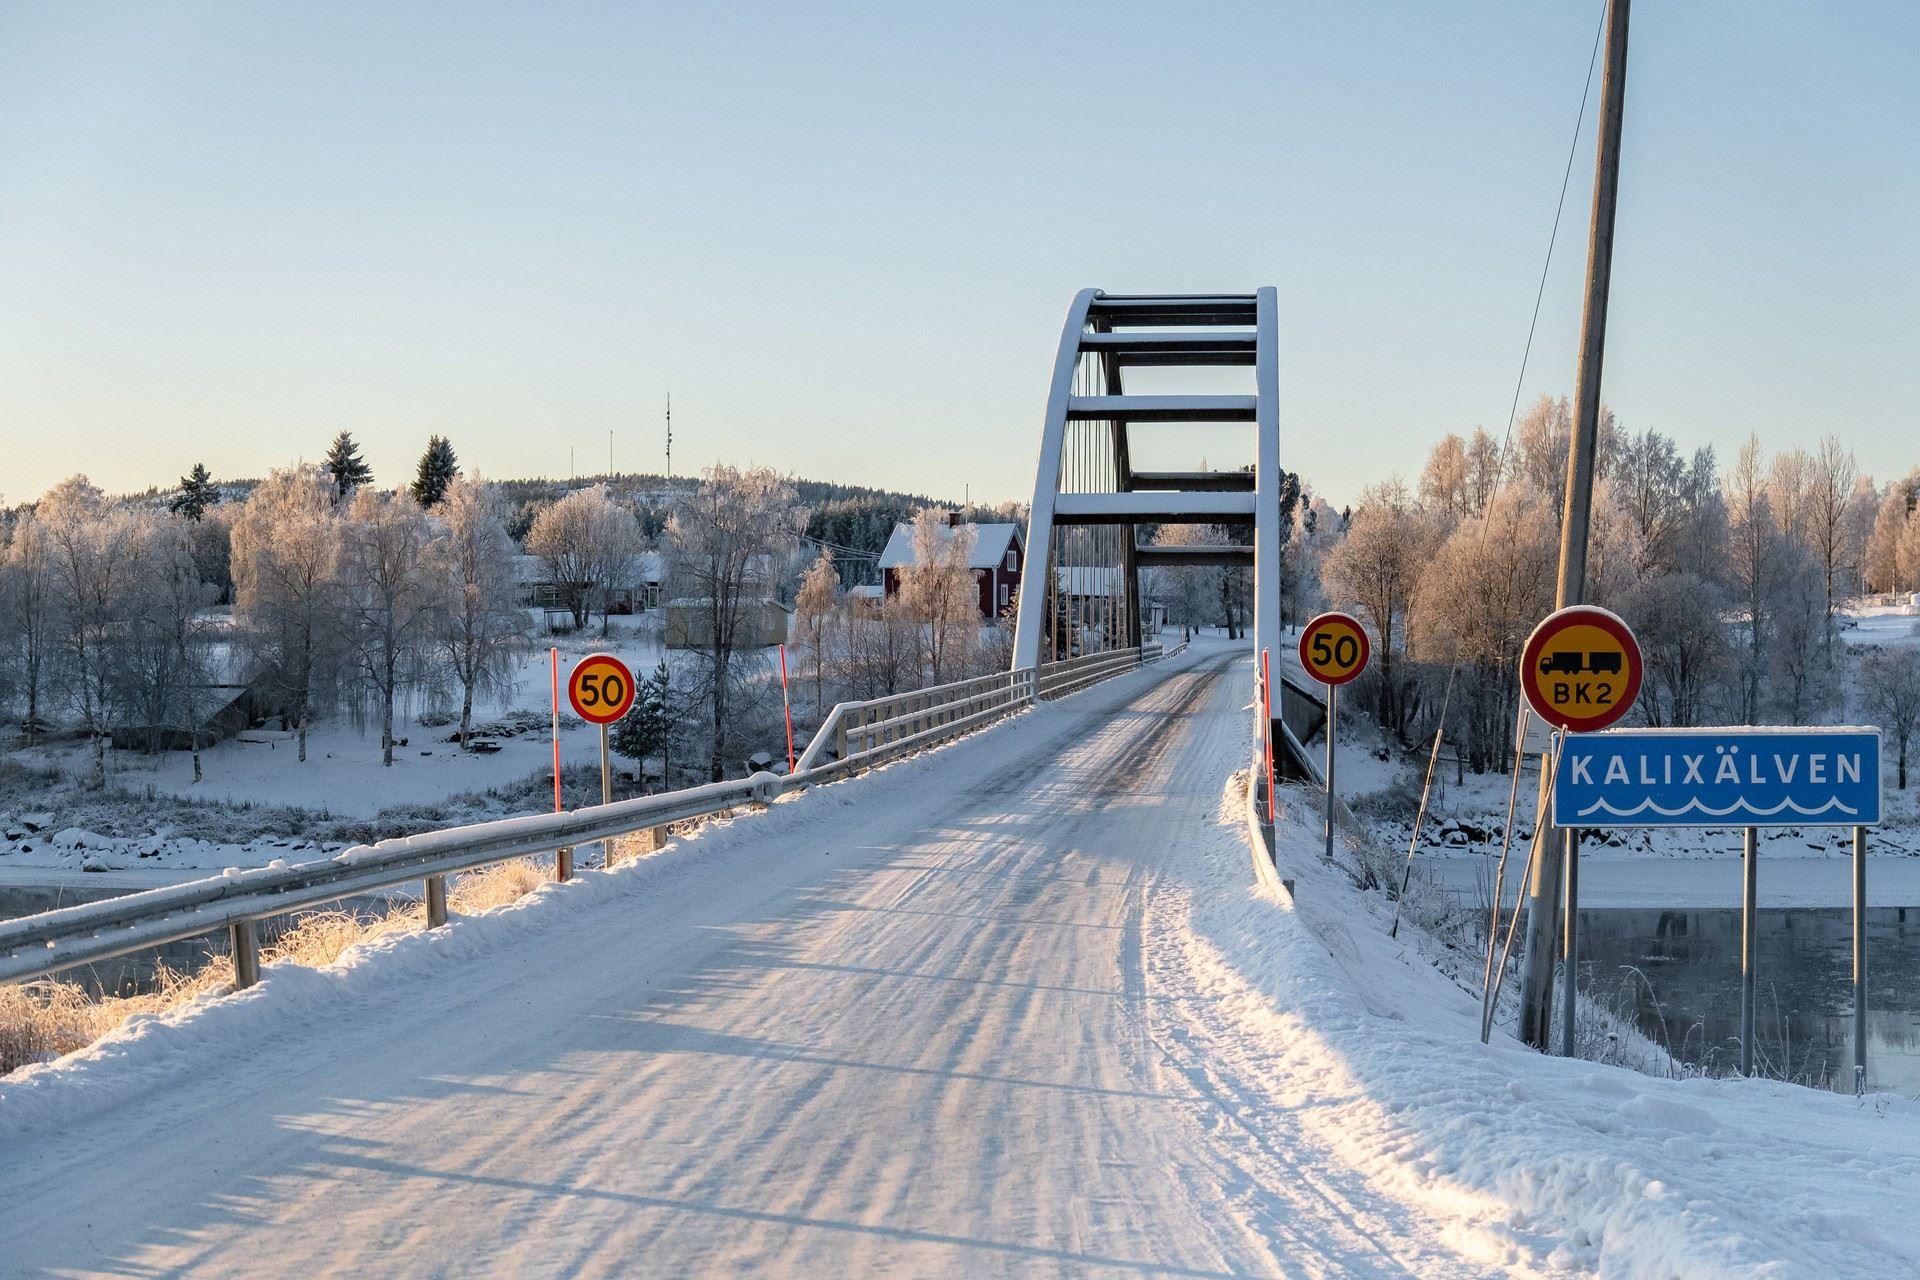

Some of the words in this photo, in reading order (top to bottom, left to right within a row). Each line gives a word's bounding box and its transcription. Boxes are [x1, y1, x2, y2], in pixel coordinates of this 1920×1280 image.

[1312, 633, 1358, 668] 50
[580, 674, 624, 707] 50
[1554, 682, 1612, 704] BK2
[1571, 745, 1861, 784] KALIXÄLVEN
